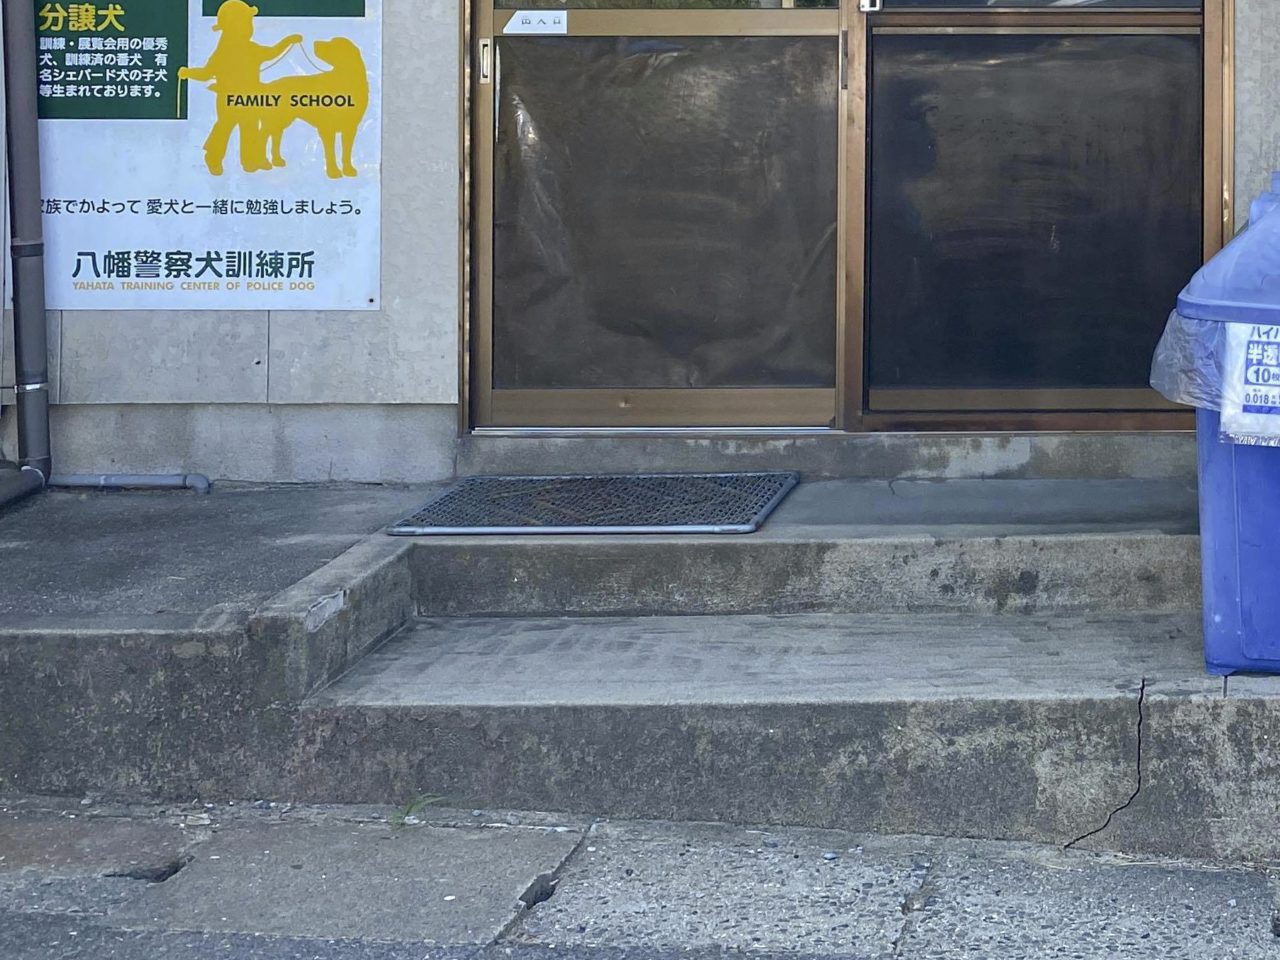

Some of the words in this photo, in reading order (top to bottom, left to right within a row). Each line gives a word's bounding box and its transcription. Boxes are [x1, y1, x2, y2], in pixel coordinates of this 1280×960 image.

[39, 3, 125, 31] 分譲犬
[40, 37, 168, 50] 訓練・展覧会用の優秀
[39, 53, 143, 66] 犬、訓練済の番犬
[155, 53, 168, 66] 有
[39, 84, 161, 97] 等生まれております。
[227, 95, 281, 107] FAMILY
[290, 95, 355, 107] SCHOOL
[147, 199, 362, 215] 愛犬と一緒に勉強しましょう。
[72, 250, 315, 279] 八幡警察犬訓練所
[72, 282, 115, 290] YAHATA
[121, 282, 174, 290] TRAINING
[181, 282, 220, 290] CENTER
[226, 282, 241, 290] OF
[247, 282, 283, 290] POLICE
[289, 282, 315, 290] DOG
